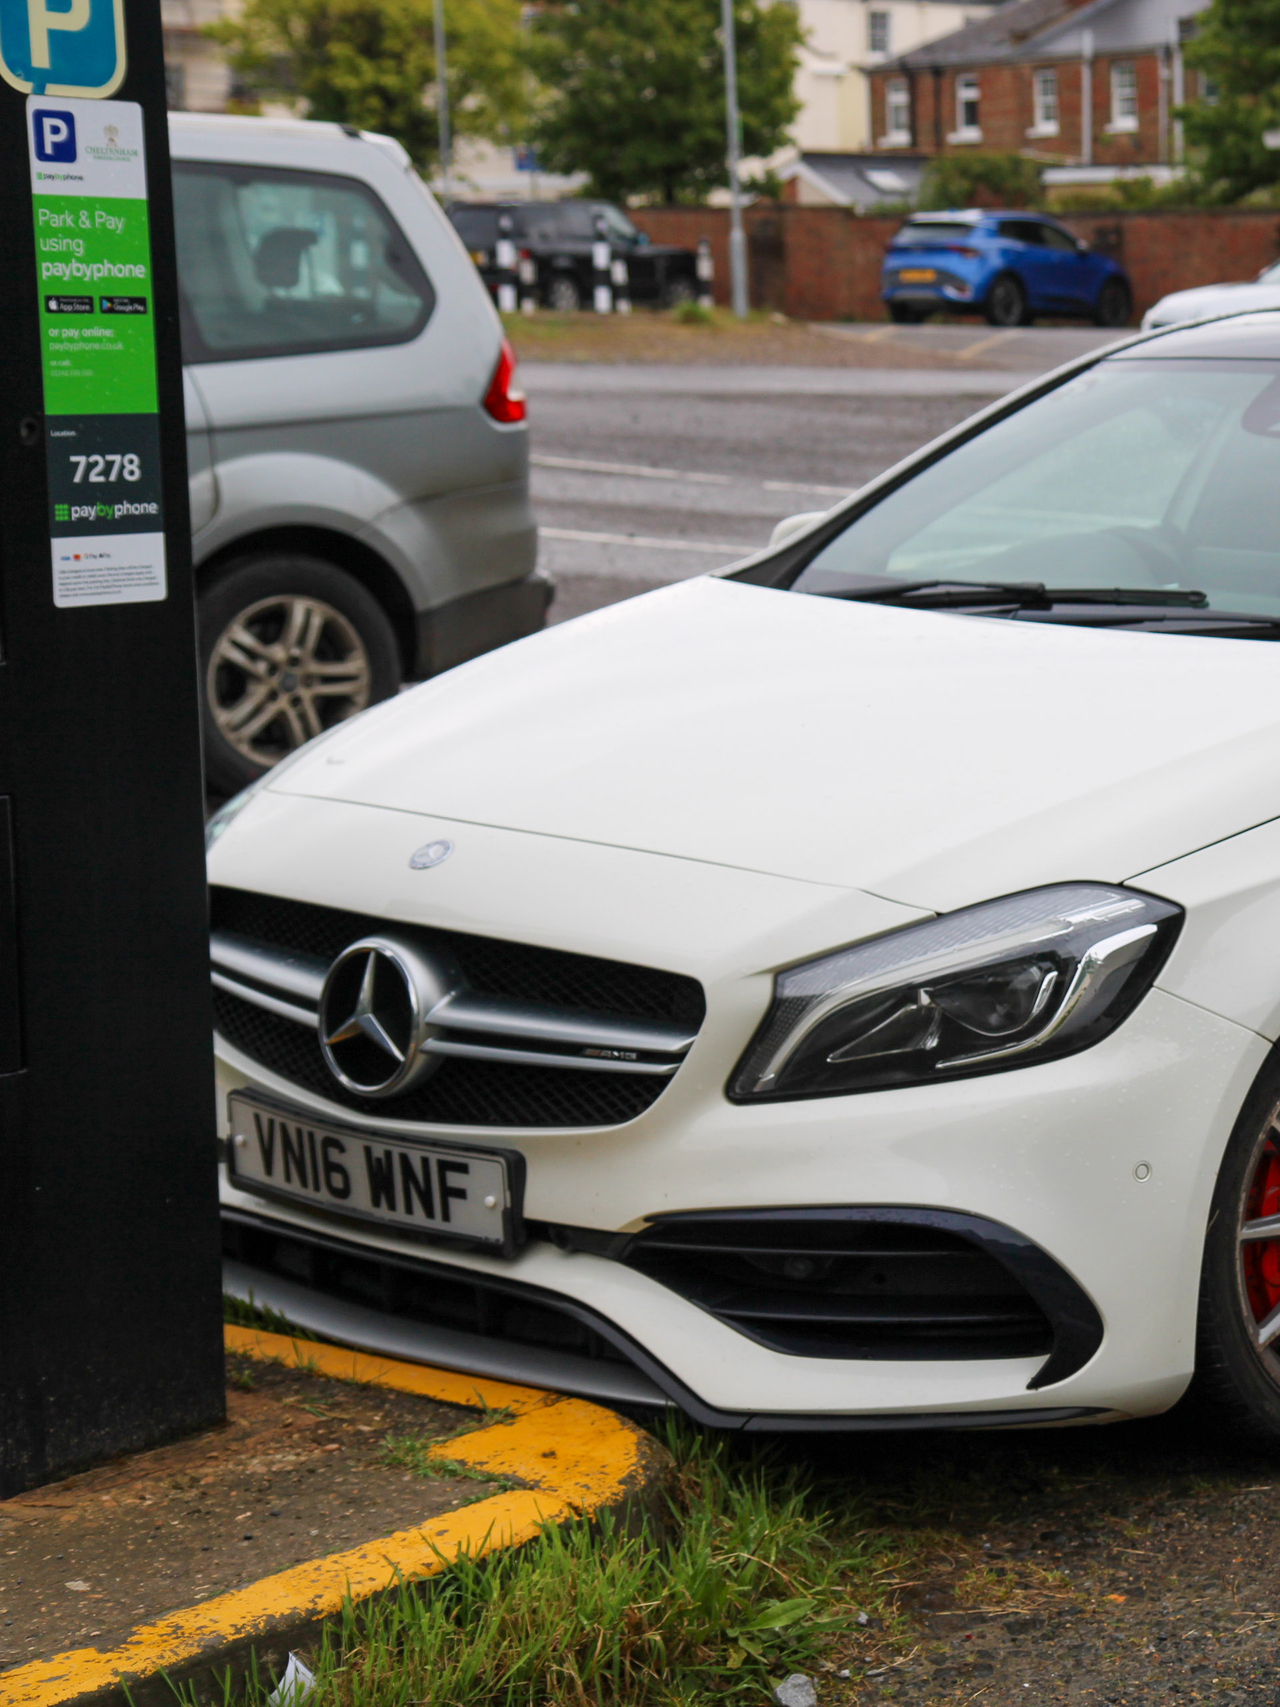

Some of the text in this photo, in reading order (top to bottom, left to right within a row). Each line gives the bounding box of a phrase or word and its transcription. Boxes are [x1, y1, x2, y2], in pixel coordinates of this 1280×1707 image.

[27, 0, 91, 69] P
[42, 117, 68, 155] P
[85, 146, 138, 156] CHELTENHAM
[43, 172, 84, 181] paybyphone
[38, 208, 125, 234] Park & Pay
[40, 233, 84, 257] using
[41, 258, 146, 281] paybyphone
[60, 302, 91, 311] App Store
[113, 303, 132, 312] Google
[49, 326, 115, 339] or pay online:
[49, 341, 124, 352] paybyphone.co.uk
[50, 429, 76, 437] Location
[69, 453, 142, 483] 7278
[71, 500, 159, 521] paybyphone
[253, 1112, 470, 1223] VN16 WNF
